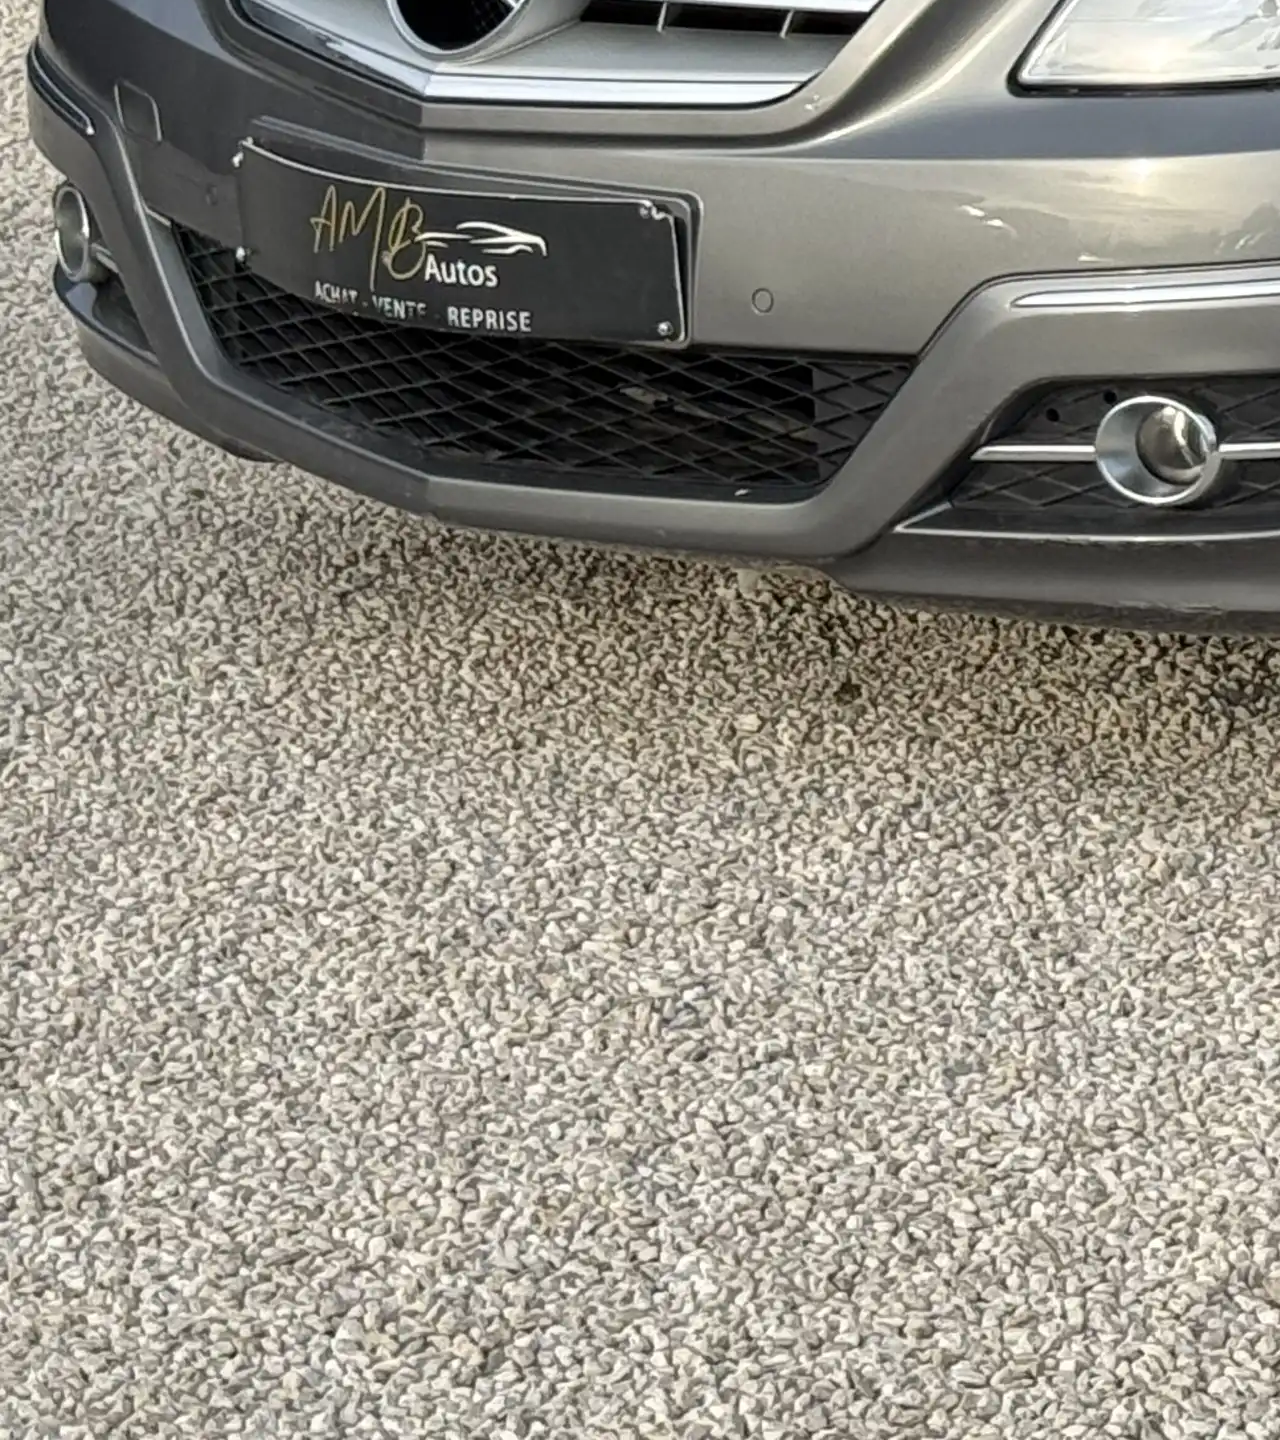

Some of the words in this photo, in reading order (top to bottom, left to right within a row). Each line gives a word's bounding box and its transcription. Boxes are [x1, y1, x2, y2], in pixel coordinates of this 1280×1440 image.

[310, 185, 428, 292] AMB
[424, 253, 499, 288] Autos
[314, 280, 358, 305] ACHAT
[371, 294, 427, 320] VENTE
[447, 305, 533, 333] REPRISE
